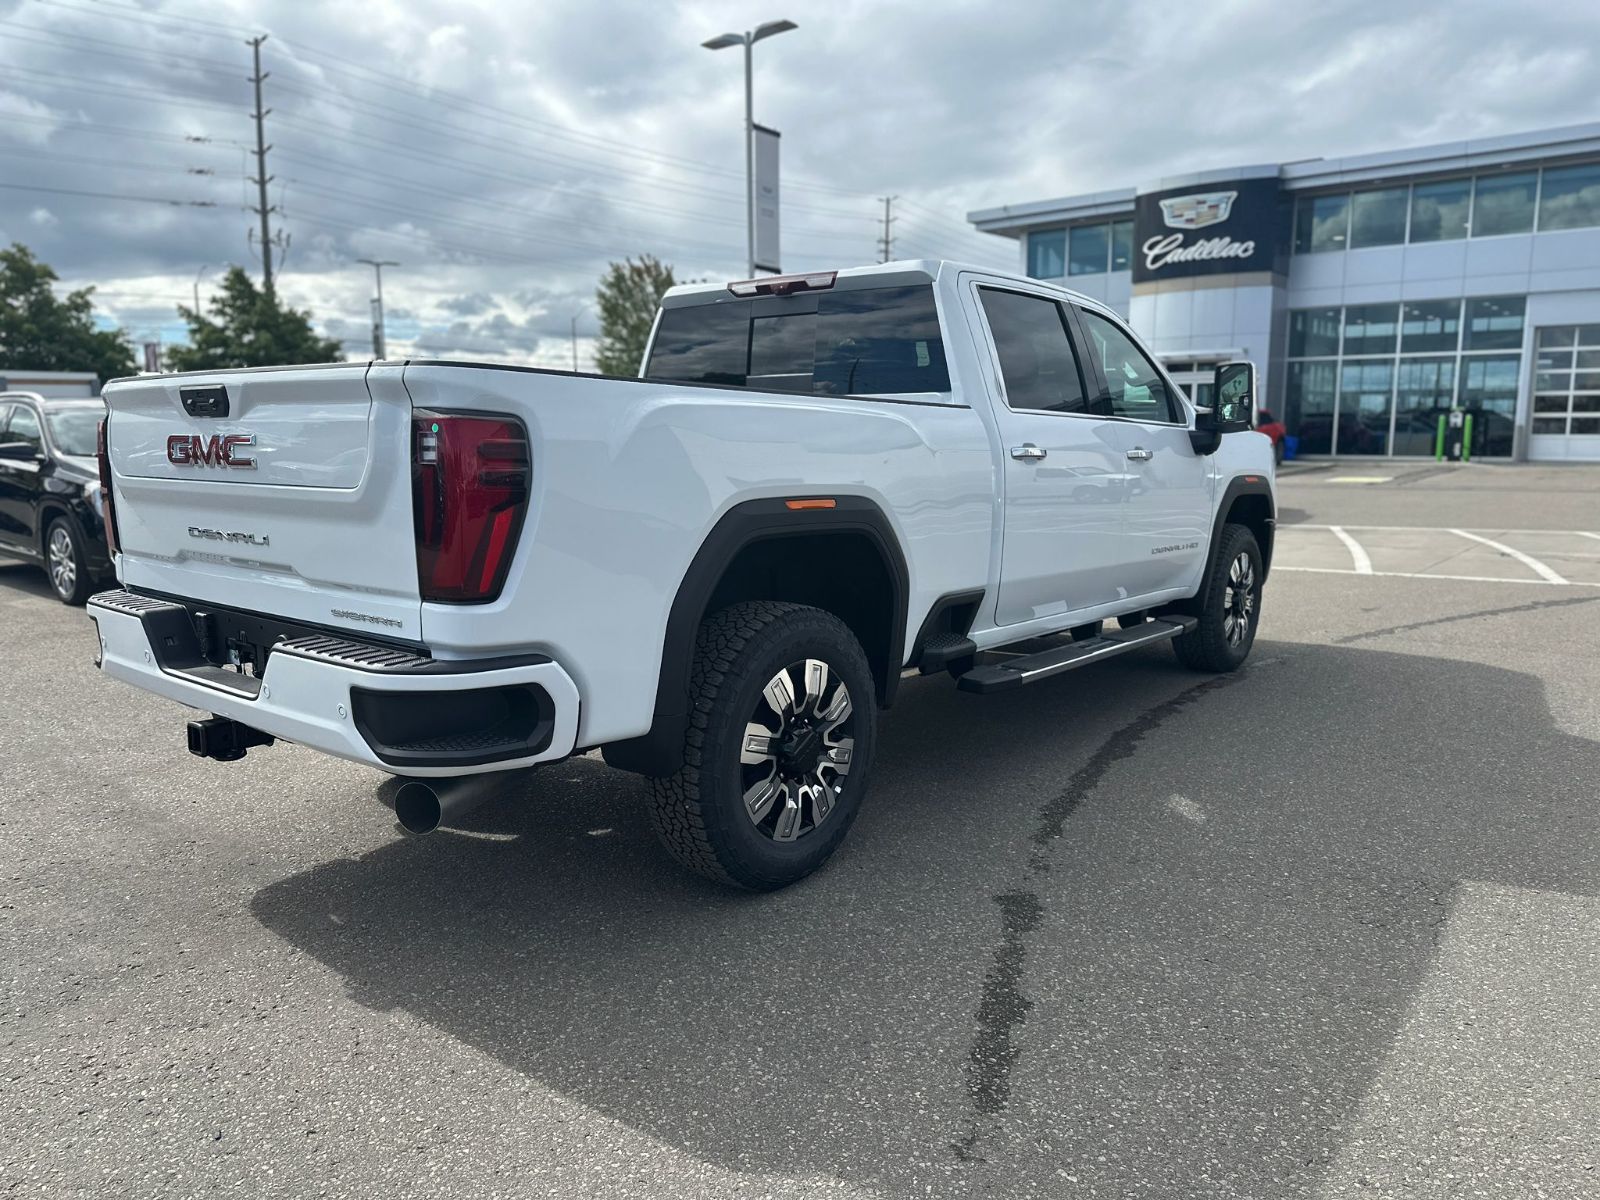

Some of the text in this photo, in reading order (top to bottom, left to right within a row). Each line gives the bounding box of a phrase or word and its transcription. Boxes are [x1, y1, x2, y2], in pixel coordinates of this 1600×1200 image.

[1142, 233, 1255, 270] Cadillac
[167, 433, 257, 470] GMC
[187, 526, 270, 547] DENALI
[330, 609, 403, 628] SIERRA
